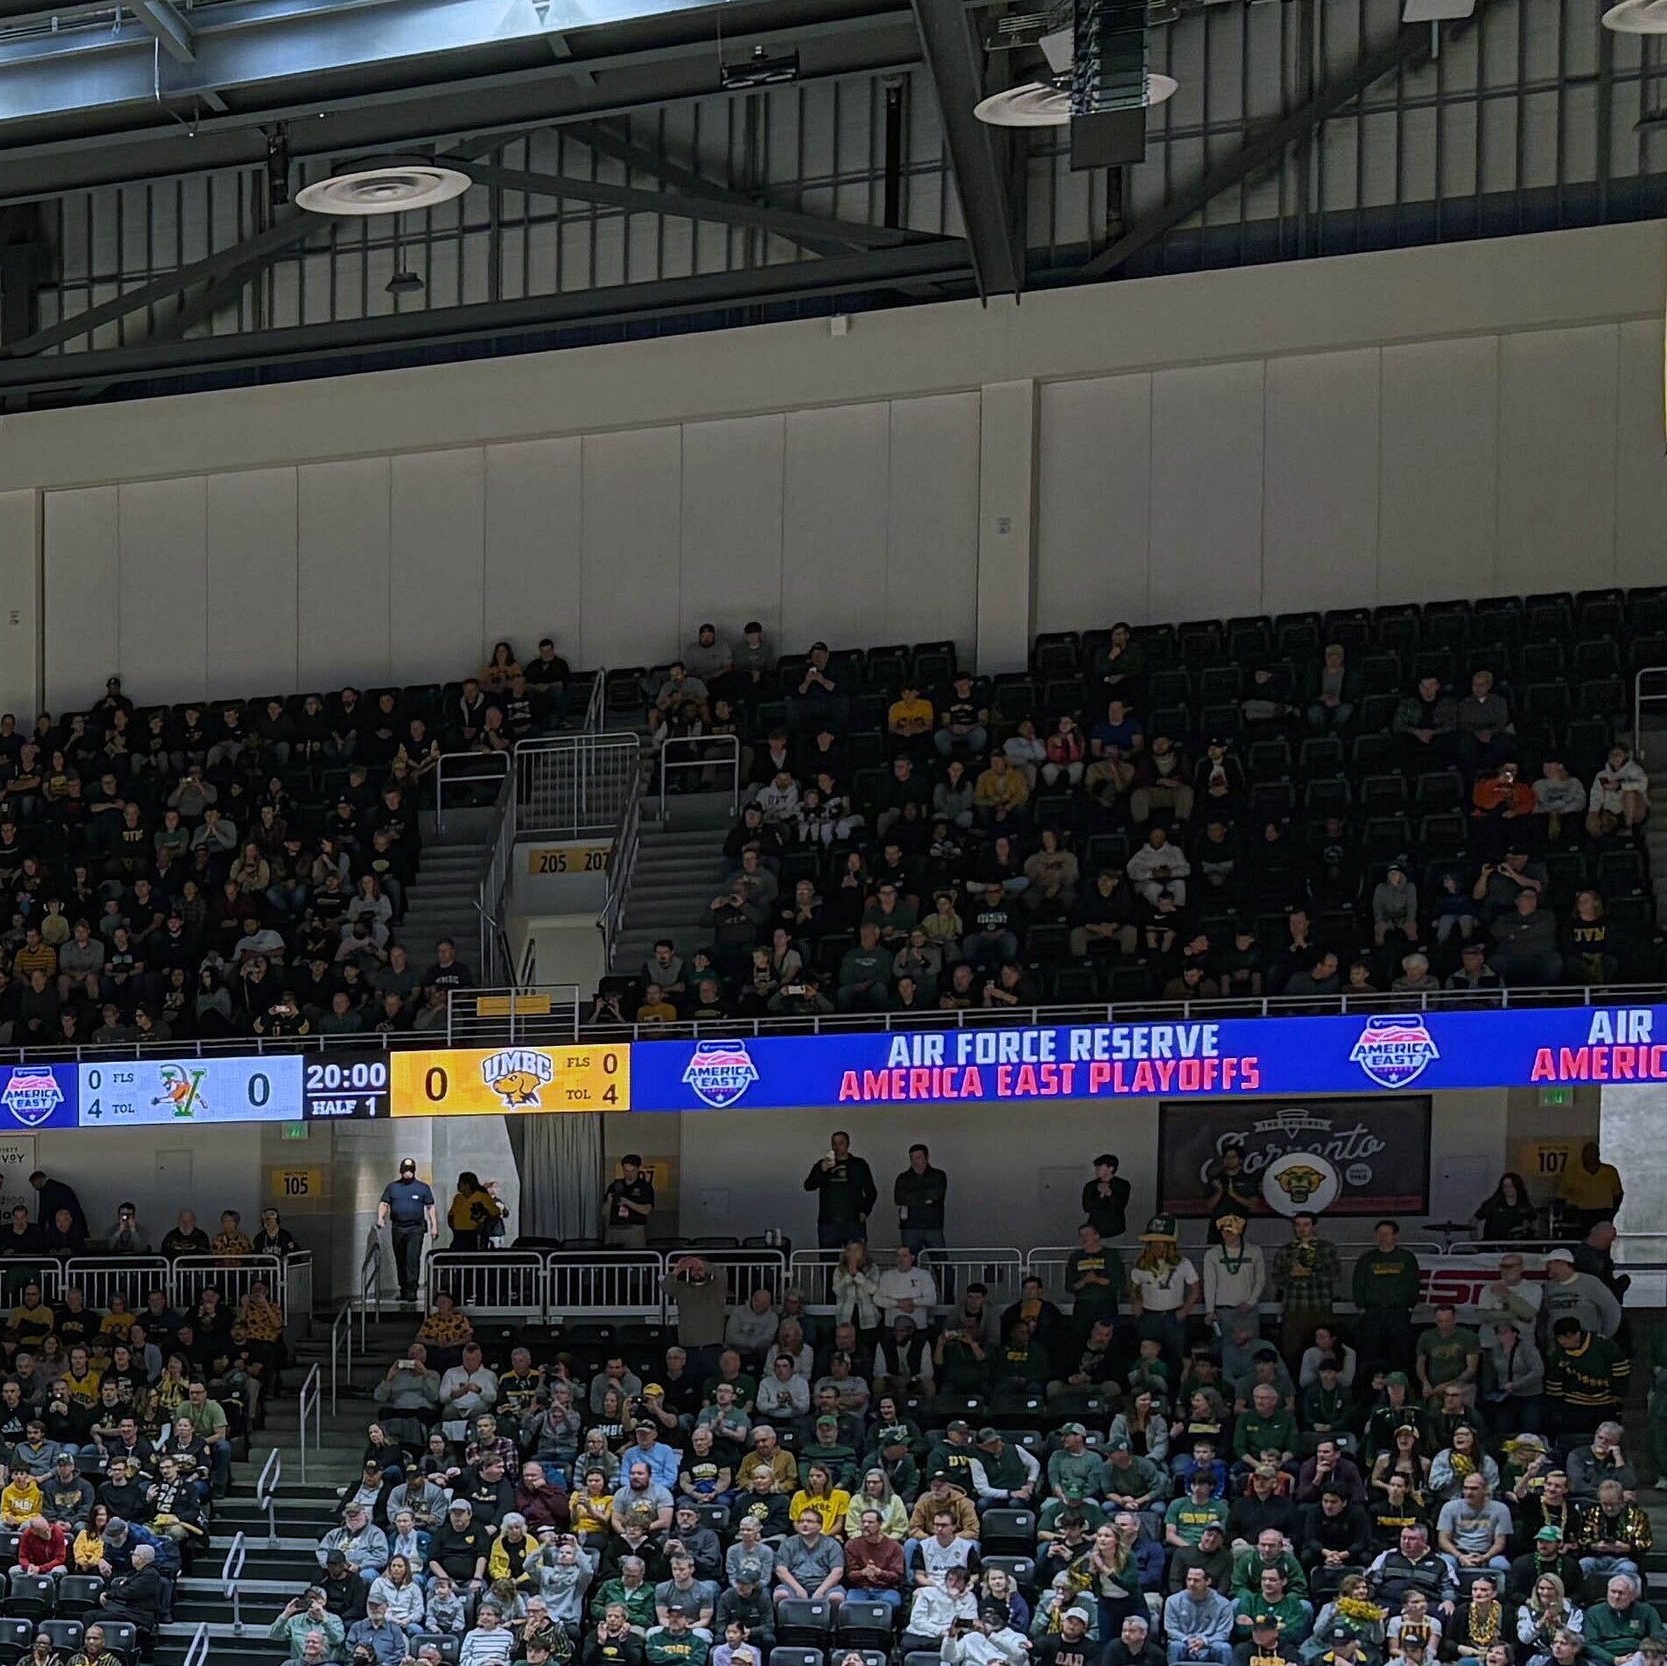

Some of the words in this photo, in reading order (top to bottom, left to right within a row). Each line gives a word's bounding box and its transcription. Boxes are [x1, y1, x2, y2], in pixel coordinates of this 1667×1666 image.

[539, 854, 567, 874] 205
[1589, 1009, 1653, 1045] AIR
[888, 1034, 950, 1068] AIR
[957, 1028, 1057, 1066] FORCE
[1070, 1023, 1220, 1061] RESERVE
[482, 1049, 553, 1082] UMBC
[566, 1056, 591, 1068] FLS
[602, 1053, 618, 1075] 0
[1372, 1054, 1415, 1066] EAST
[88, 1069, 102, 1090] 0
[113, 1072, 134, 1083] FLS
[306, 1062, 387, 1090] 20:00
[688, 1066, 755, 1080] AMERICA
[701, 1076, 739, 1087] EAST
[839, 1065, 984, 1101] AMERICA
[998, 1062, 1076, 1097] EAST
[1090, 1056, 1260, 1094] PLAYOFFS
[247, 1072, 270, 1107] 0
[425, 1066, 448, 1102] 0
[565, 1088, 592, 1100] TOL
[602, 1083, 619, 1105] 4
[87, 1098, 103, 1119] 4
[111, 1103, 135, 1114] TOL
[311, 1099, 357, 1116] HALF
[365, 1096, 377, 1117] 1
[1538, 1152, 1568, 1173] 107
[282, 1176, 309, 1196] 105
